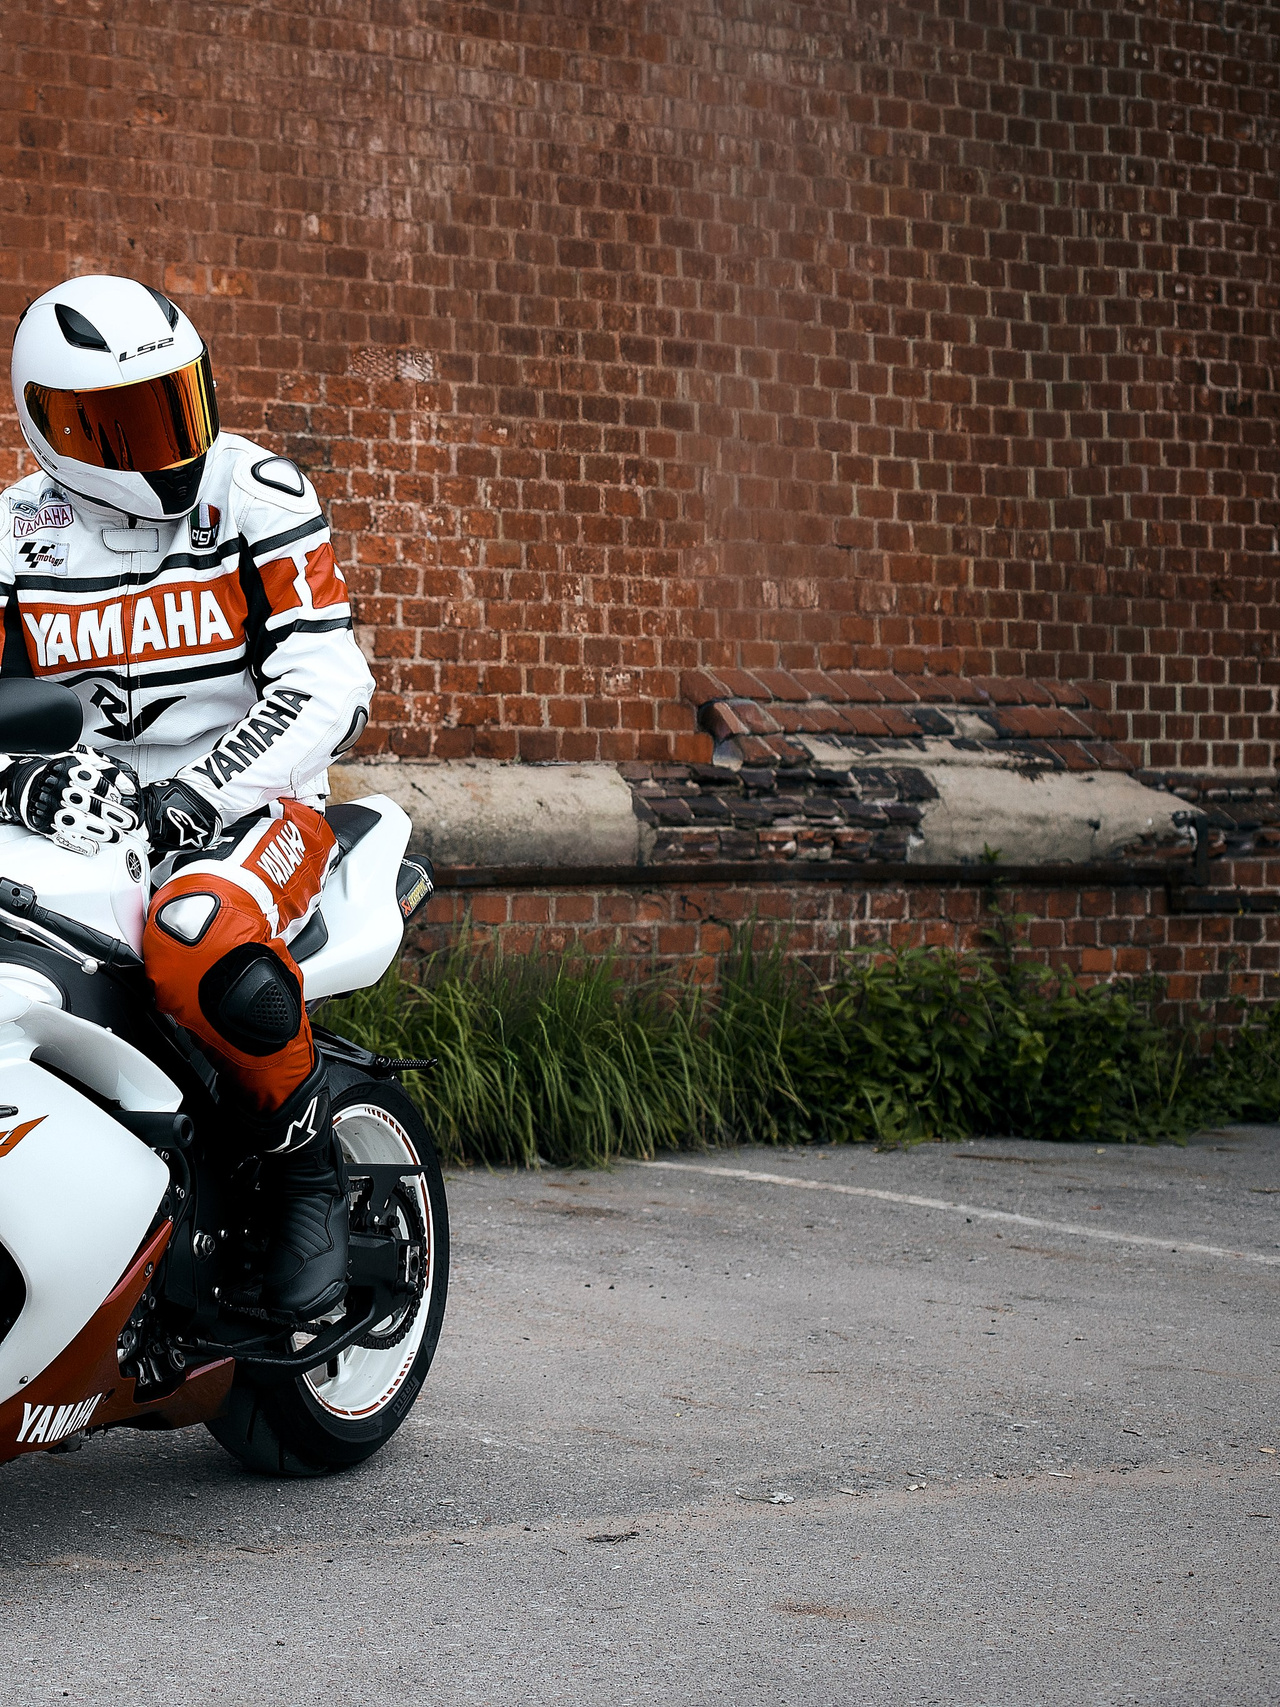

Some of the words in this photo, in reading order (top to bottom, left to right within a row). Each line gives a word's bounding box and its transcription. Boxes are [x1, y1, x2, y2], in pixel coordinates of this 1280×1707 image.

[119, 337, 174, 362] LS2
[17, 508, 71, 535] YAMAHA
[22, 590, 234, 667] YAMAHA
[192, 690, 313, 790] YAMAHA
[16, 1392, 103, 1443] YAMAHA
[392, 1375, 420, 1418] PIRELLI
